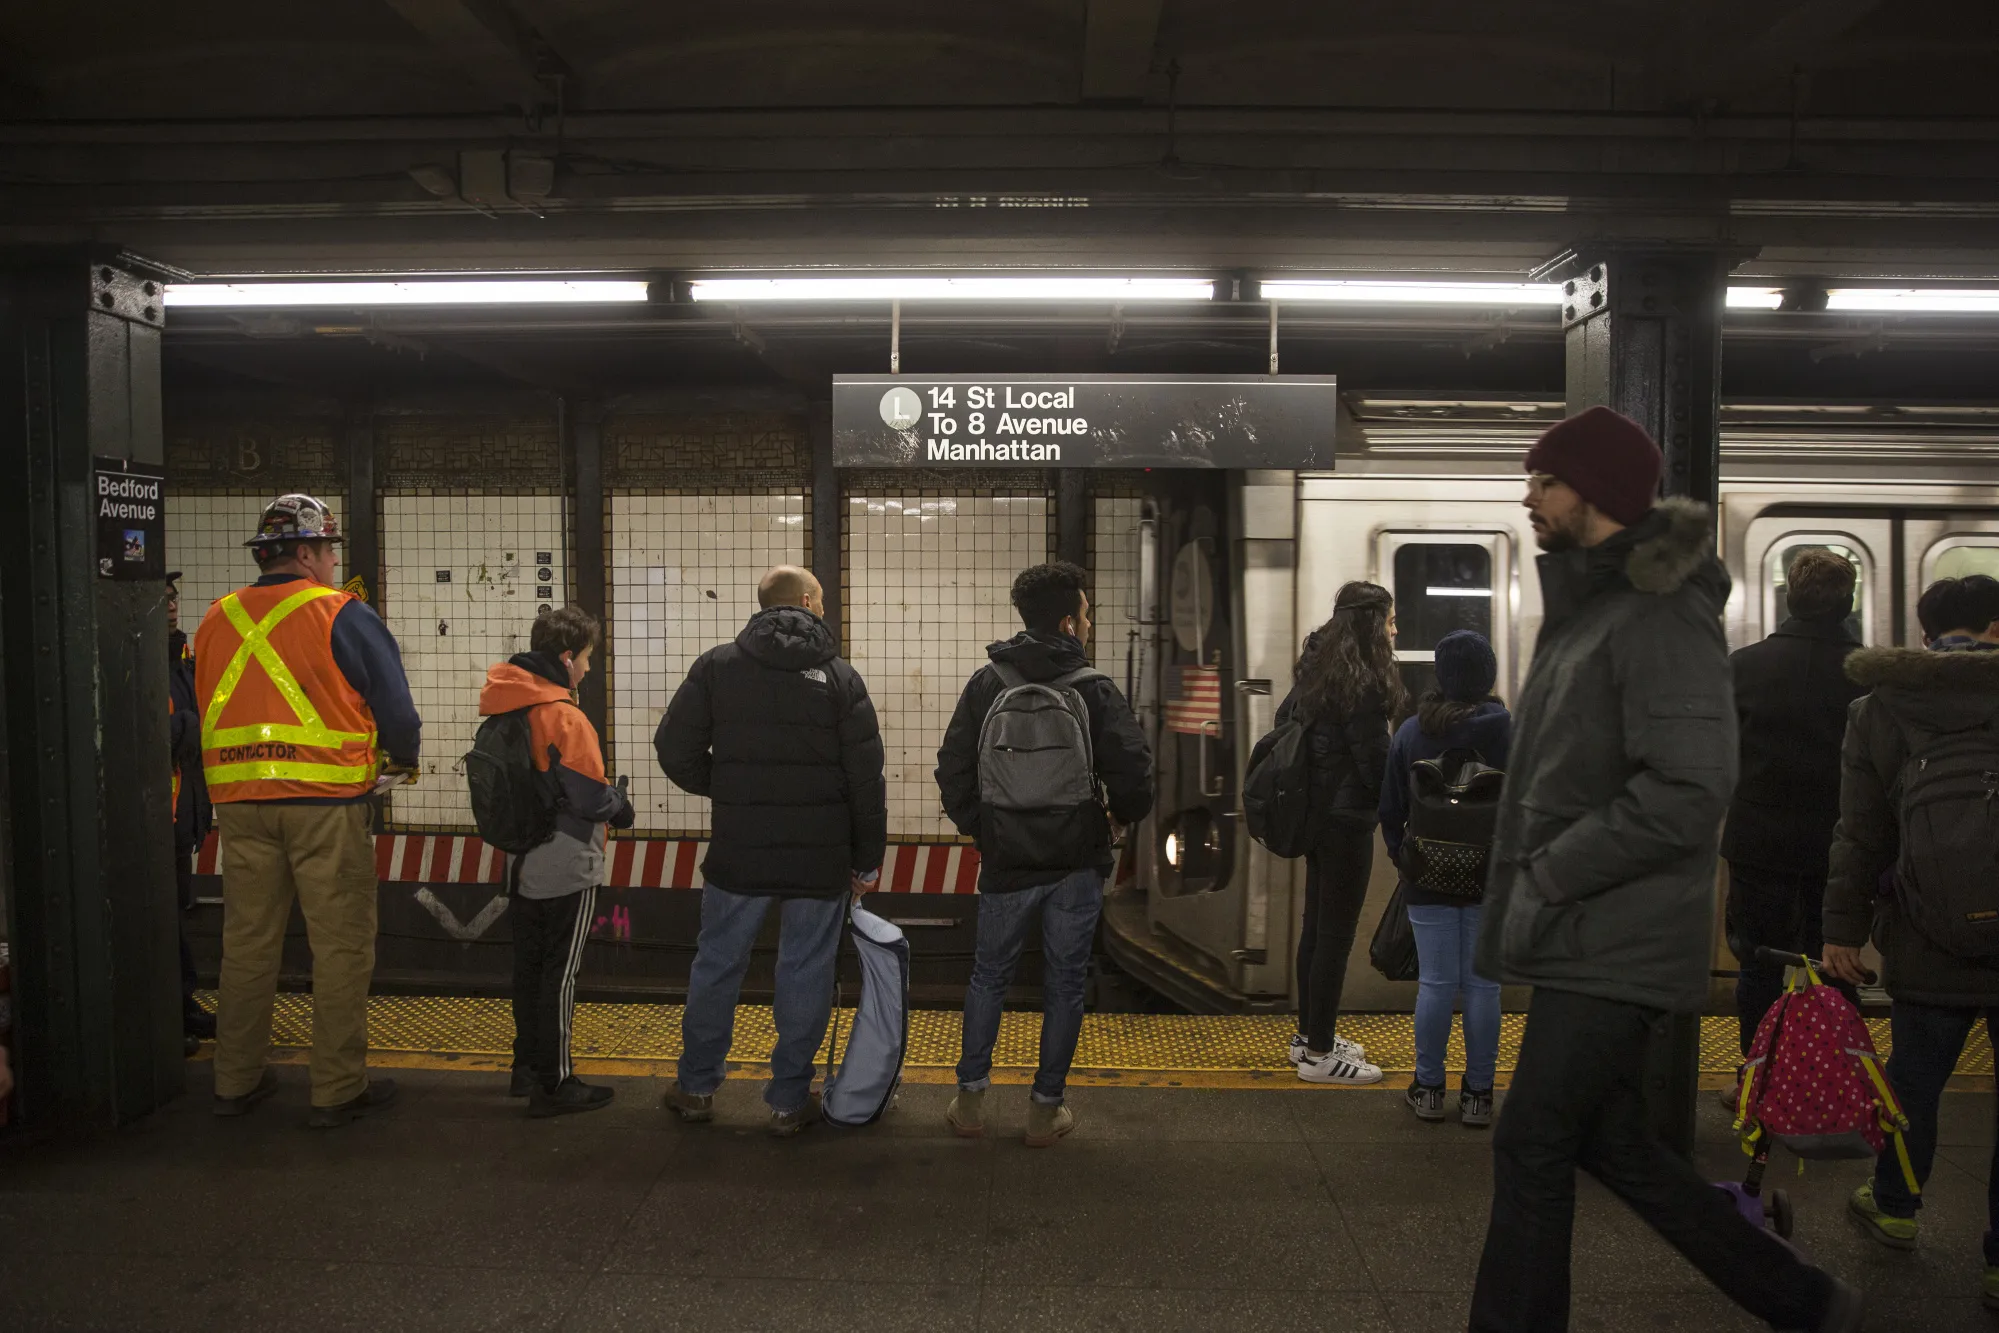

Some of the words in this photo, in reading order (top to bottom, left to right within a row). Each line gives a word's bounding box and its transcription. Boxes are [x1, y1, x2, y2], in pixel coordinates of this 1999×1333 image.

[893, 396, 911, 420] L
[927, 386, 957, 409] 14
[966, 386, 996, 410] St
[1005, 386, 1076, 410] Local
[927, 412, 958, 435] To
[967, 411, 986, 435] 8
[995, 412, 1088, 435] Avenue
[237, 438, 261, 471] B
[927, 438, 1062, 461] Manhattan
[98, 475, 159, 500] Bedford
[99, 498, 156, 520] Avenue
